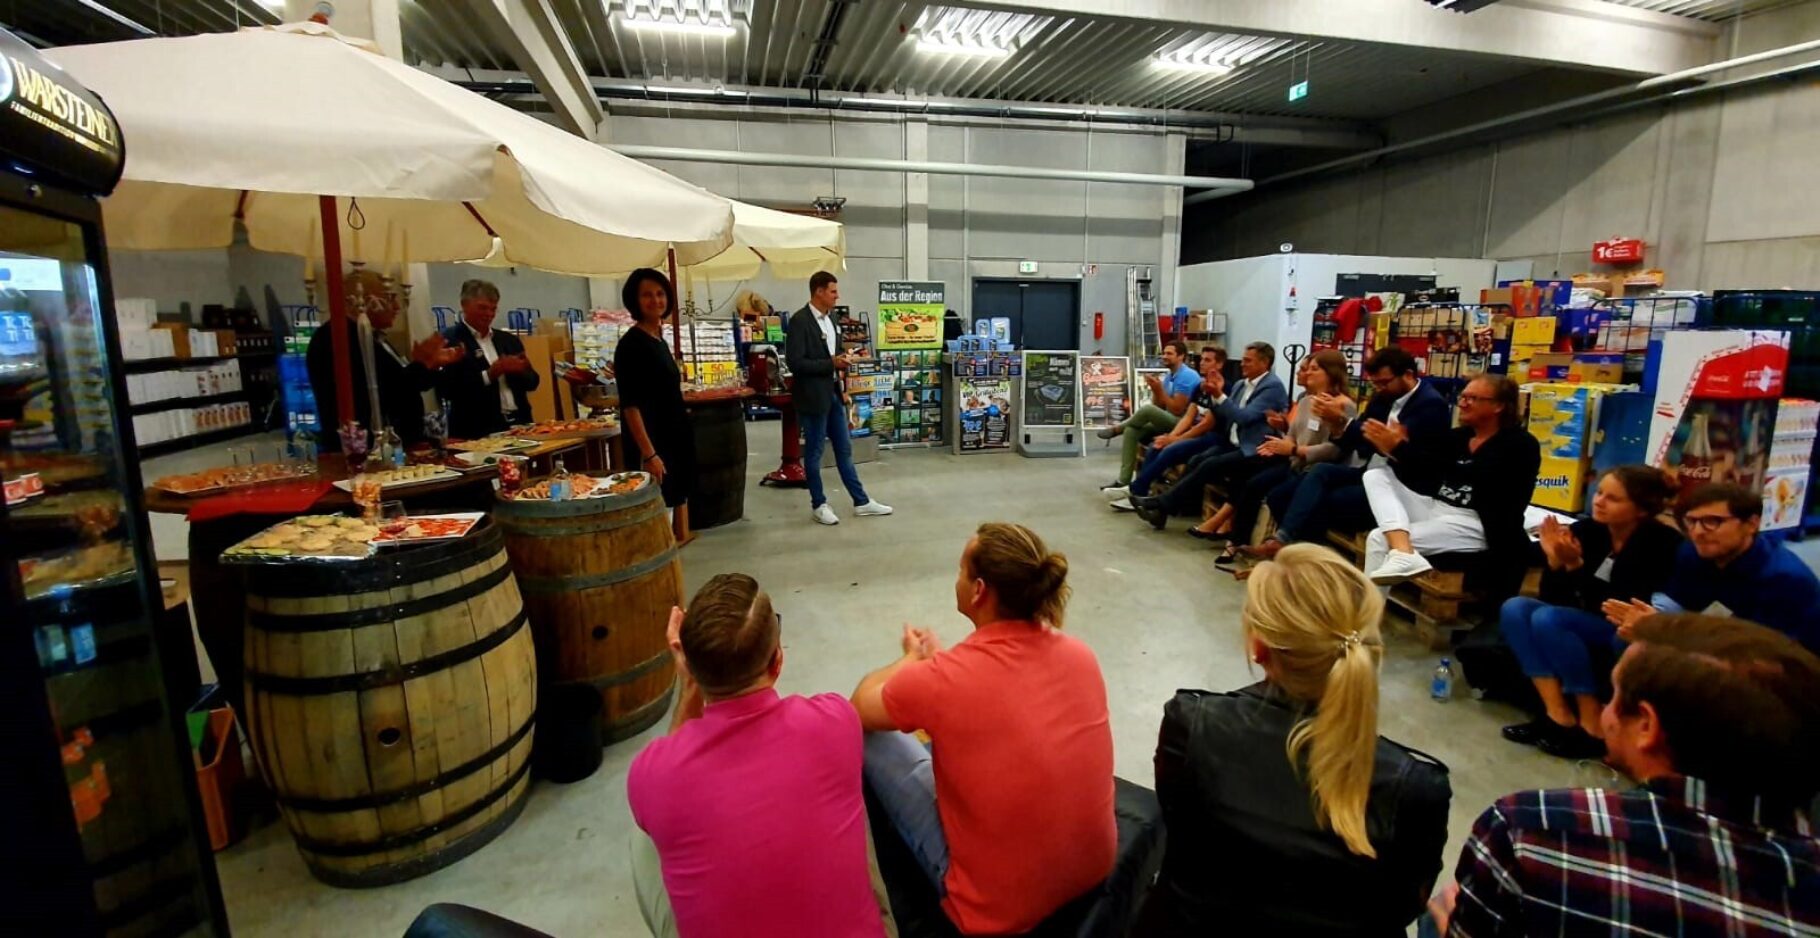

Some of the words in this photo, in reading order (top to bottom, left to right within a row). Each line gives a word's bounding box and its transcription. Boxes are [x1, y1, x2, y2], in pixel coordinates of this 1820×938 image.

[880, 290, 897, 301] Aus
[899, 290, 914, 301] der
[915, 290, 943, 304] Region
[1534, 474, 1569, 489] esquik
